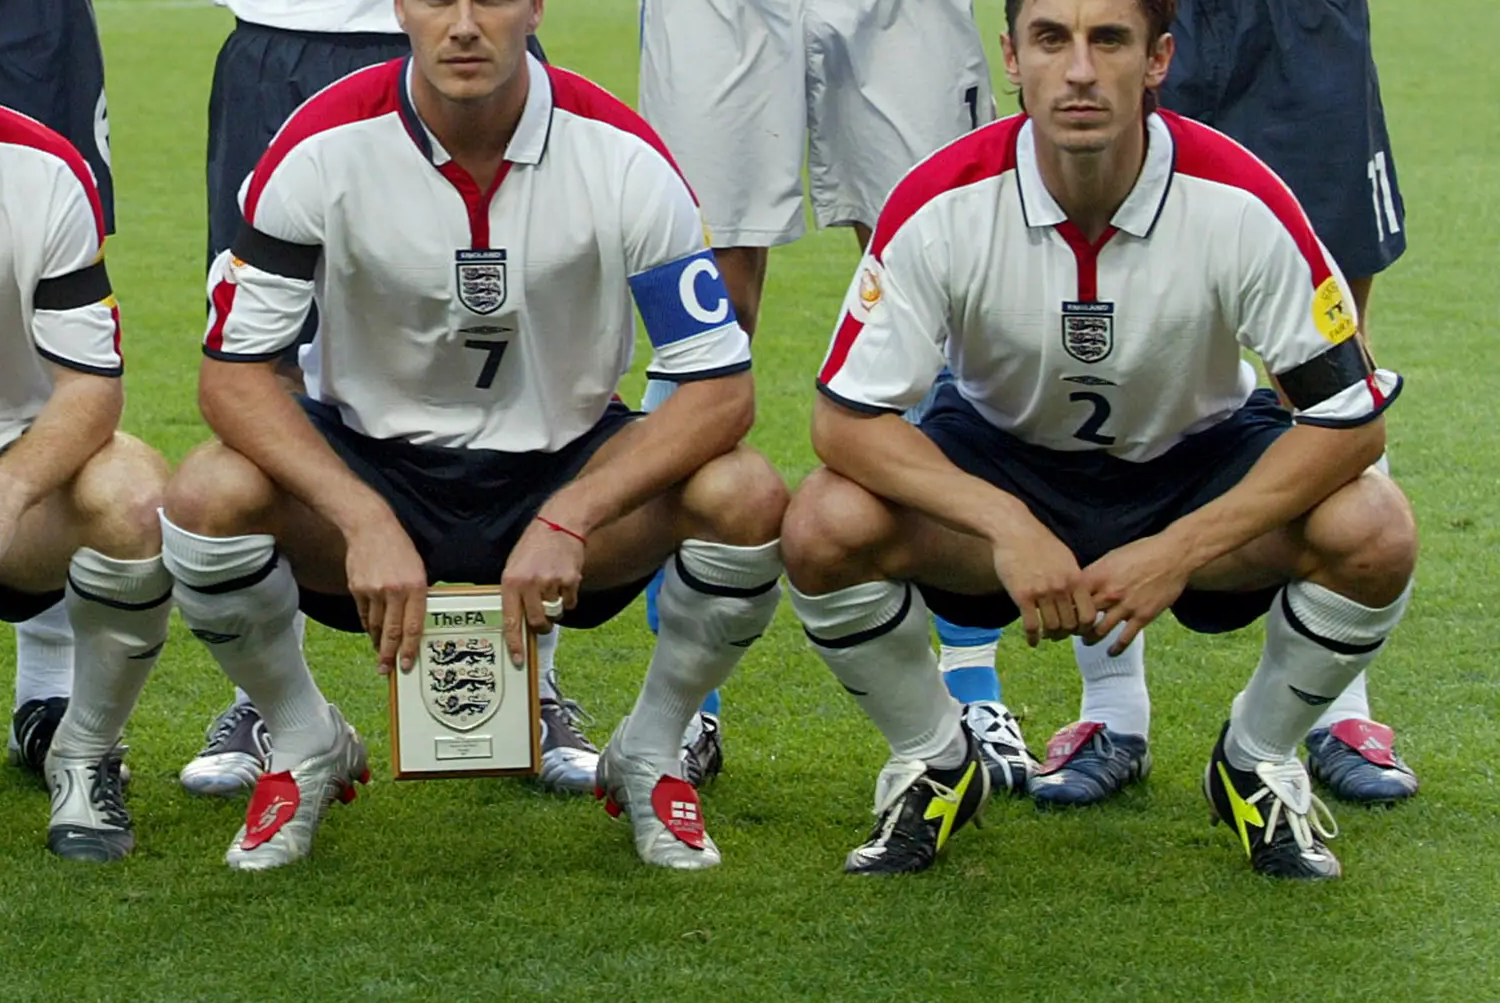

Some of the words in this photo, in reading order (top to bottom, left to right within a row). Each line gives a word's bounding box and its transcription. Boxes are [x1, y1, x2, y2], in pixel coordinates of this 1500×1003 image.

[1367, 151, 1401, 243] 11
[678, 258, 729, 324] C
[464, 340, 509, 390] 7
[1069, 392, 1116, 446] 2
